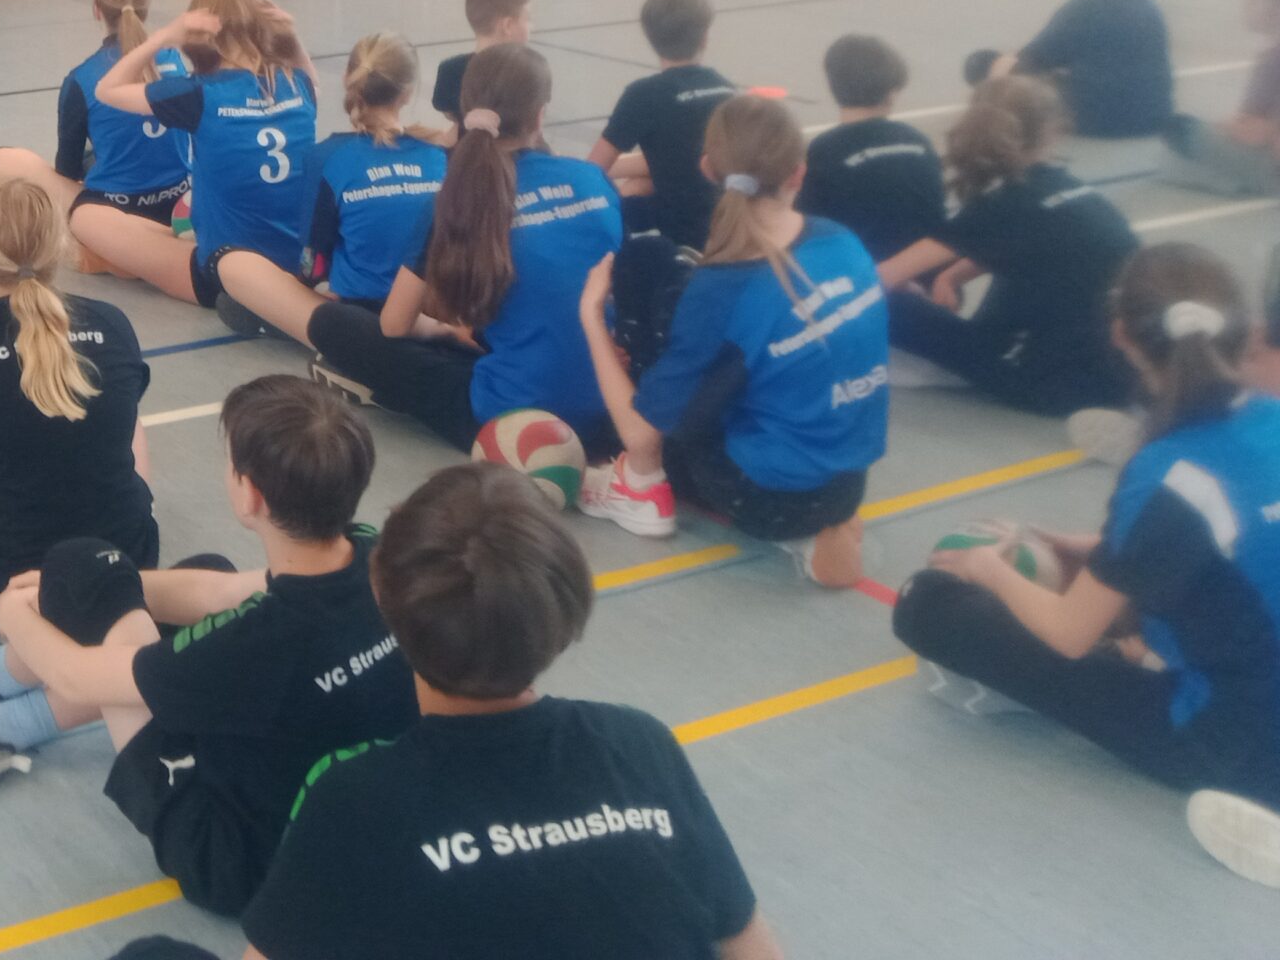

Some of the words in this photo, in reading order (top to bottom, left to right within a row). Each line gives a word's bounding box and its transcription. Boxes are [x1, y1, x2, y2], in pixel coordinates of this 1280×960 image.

[256, 127, 290, 184] 3
[314, 666, 349, 693] VC
[421, 831, 482, 873] VC
[487, 803, 674, 856] Strausberg
